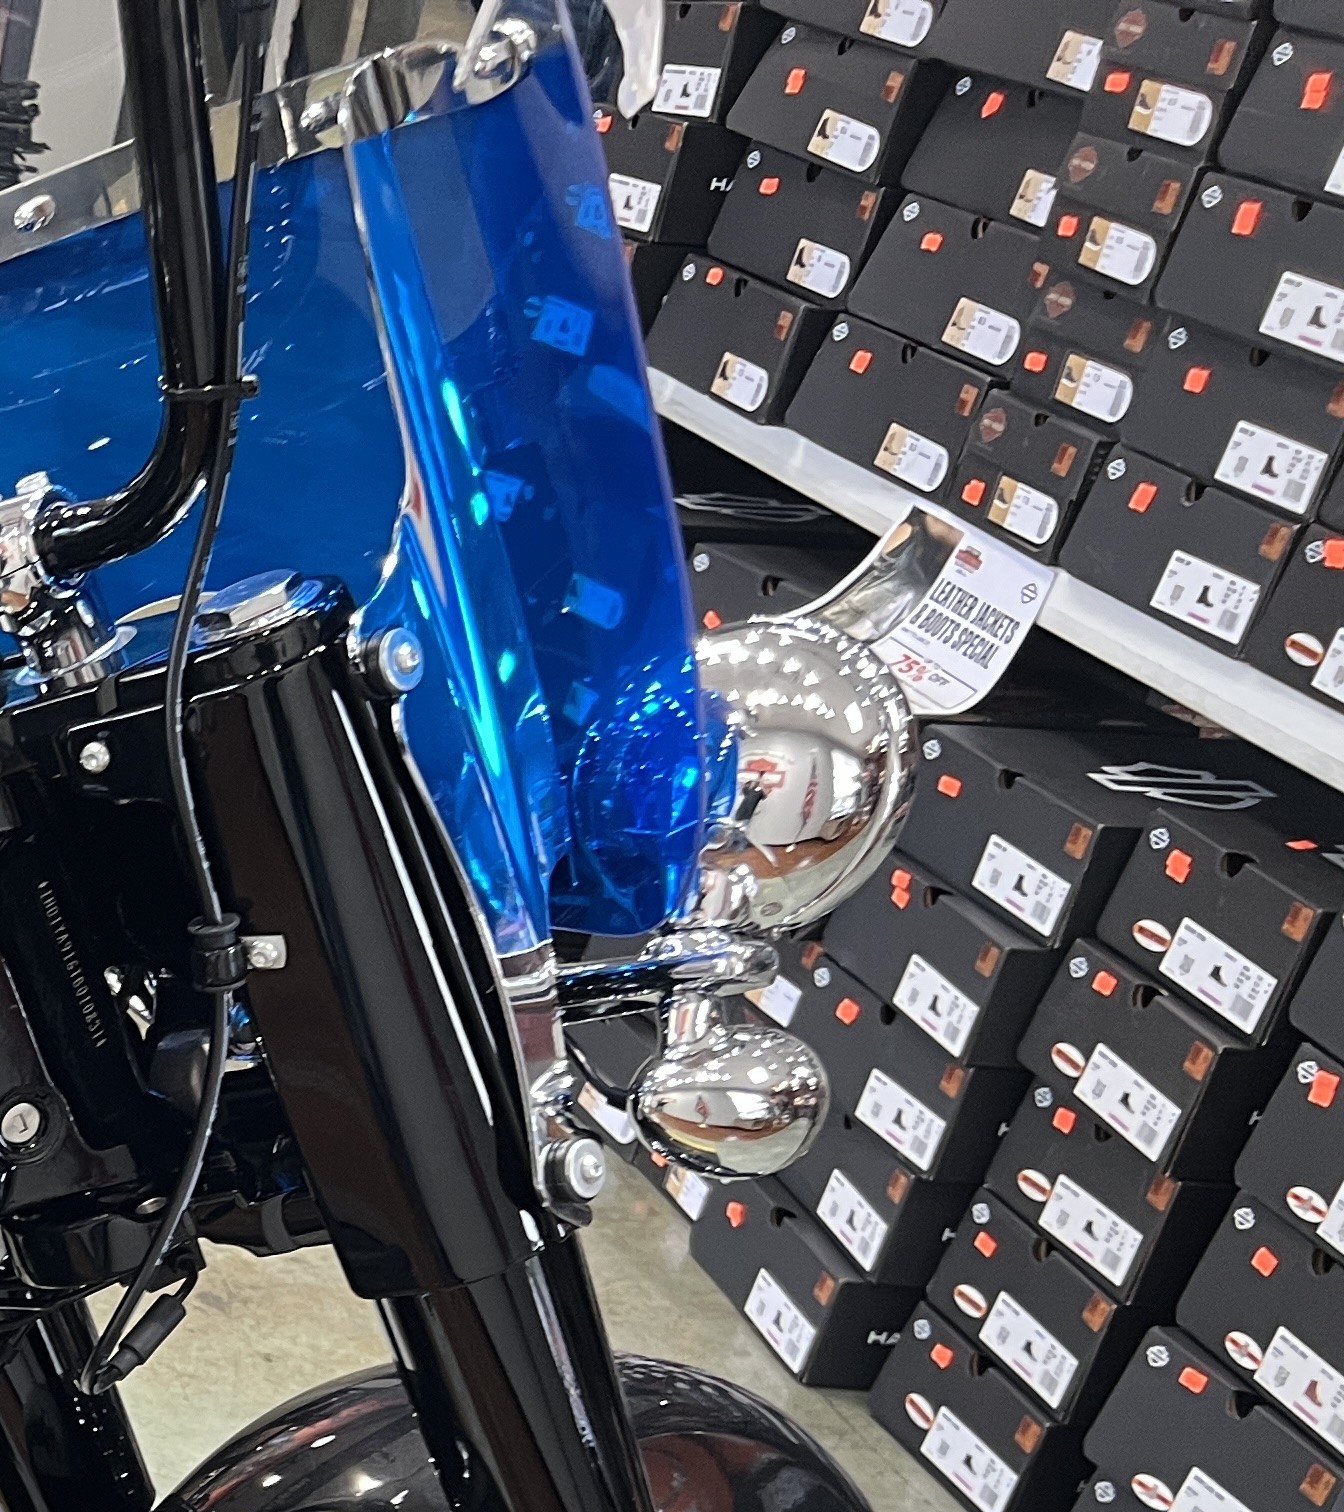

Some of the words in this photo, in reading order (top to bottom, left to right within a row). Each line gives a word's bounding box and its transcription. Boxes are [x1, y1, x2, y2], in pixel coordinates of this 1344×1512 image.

[909, 603, 929, 625] &
[918, 608, 962, 645] BOOTS
[929, 577, 979, 621] LEATHER
[970, 602, 1021, 645] JACKETS
[951, 627, 1000, 670] SPECIAL
[887, 654, 929, 682] 75%
